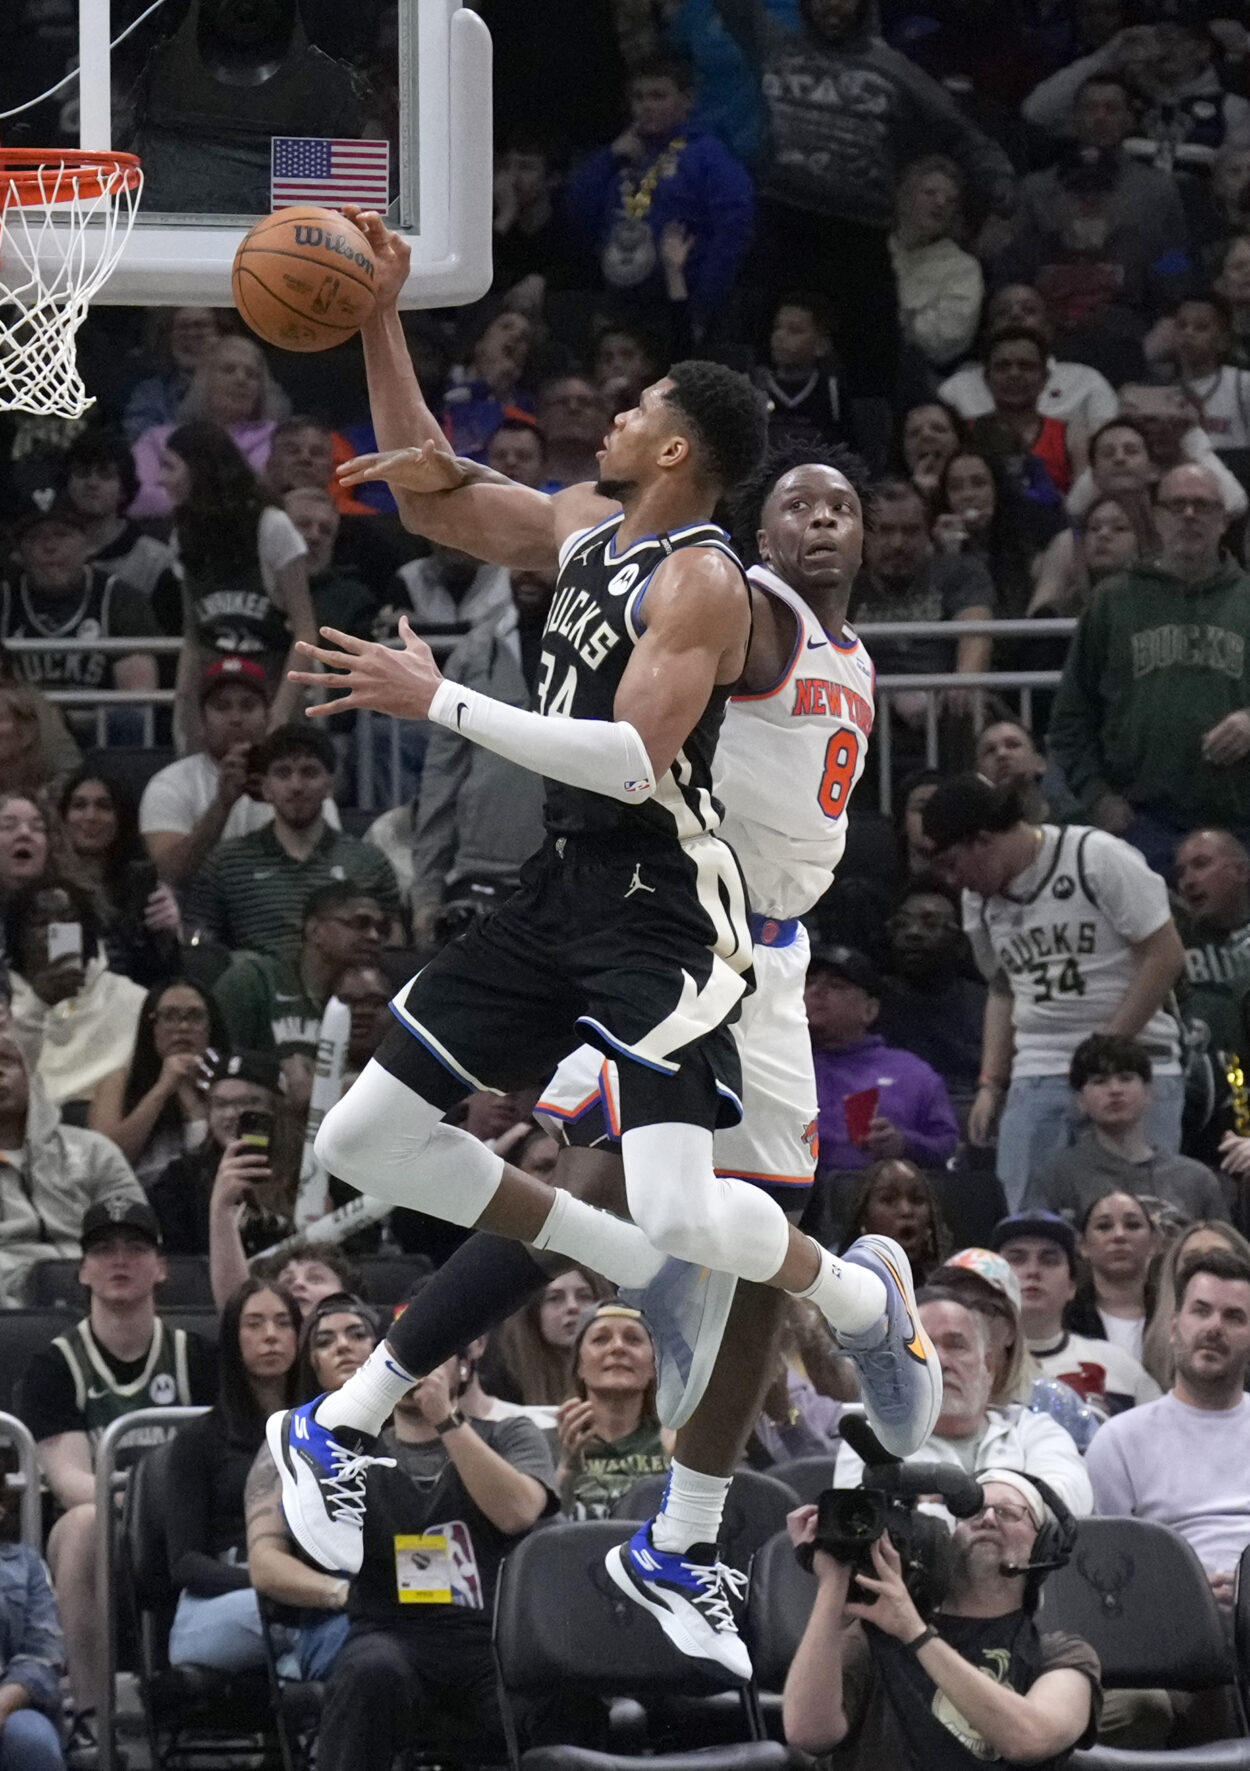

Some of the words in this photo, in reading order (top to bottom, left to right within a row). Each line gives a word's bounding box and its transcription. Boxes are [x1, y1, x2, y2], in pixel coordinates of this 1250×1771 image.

[294, 225, 376, 281] Wilson
[541, 586, 620, 671] UCKS
[12, 649, 106, 684] UCKS
[792, 679, 843, 717] NEW
[817, 727, 860, 821] 8
[1001, 922, 1096, 974] BUCKS
[1029, 948, 1086, 1003] 34
